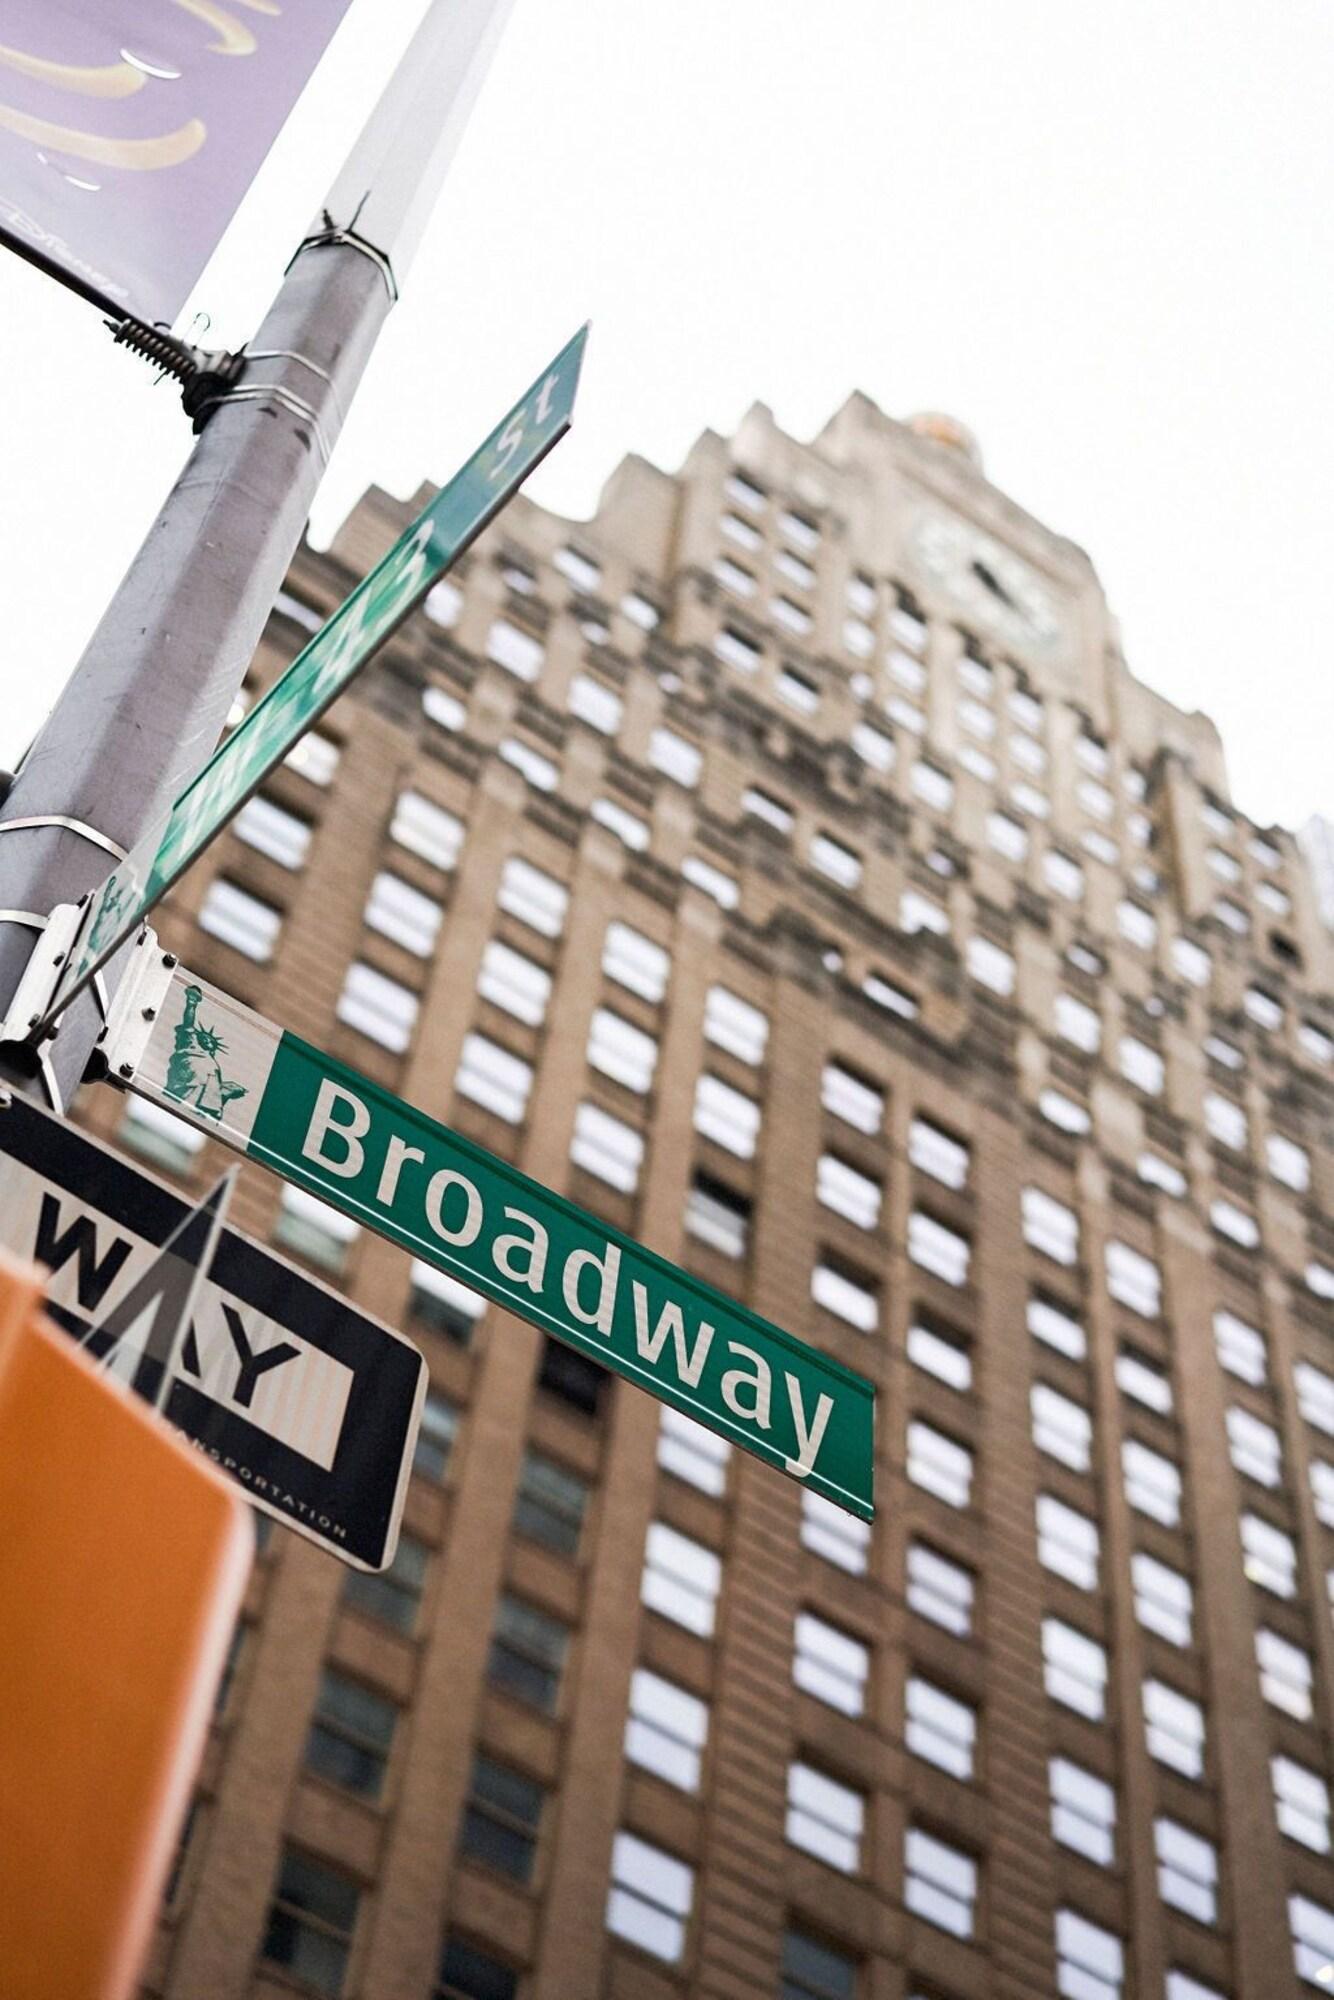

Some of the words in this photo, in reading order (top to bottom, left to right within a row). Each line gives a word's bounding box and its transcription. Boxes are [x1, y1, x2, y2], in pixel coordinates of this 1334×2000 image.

[488, 374, 560, 481] St
[34, 1191, 302, 1409] WY
[301, 1077, 834, 1477] Broadway
